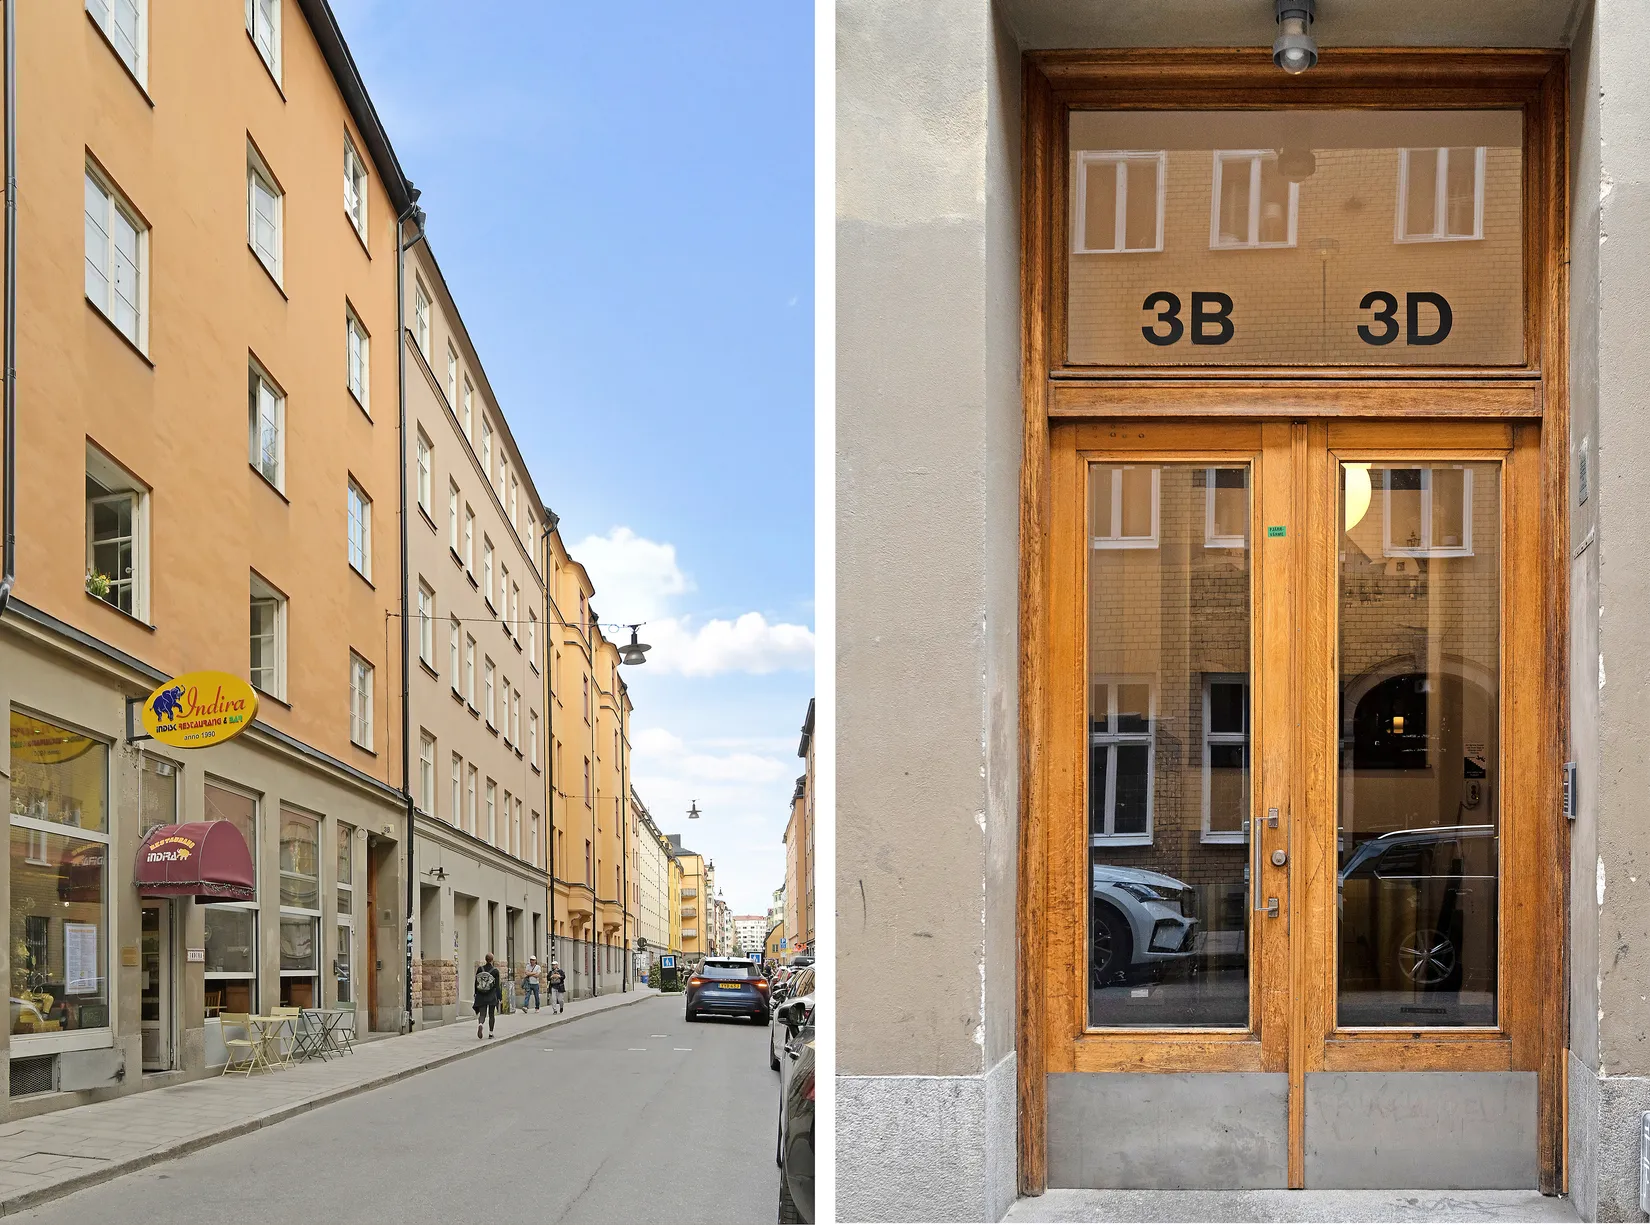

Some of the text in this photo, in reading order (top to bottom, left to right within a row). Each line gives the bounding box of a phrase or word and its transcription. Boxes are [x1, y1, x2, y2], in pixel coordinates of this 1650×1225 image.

[1141, 291, 1235, 346] 3B
[1357, 291, 1453, 346] 3D
[176, 685, 247, 719] Indira
[179, 717, 222, 731] RESTAURANG
[223, 717, 228, 725] &
[229, 714, 243, 724] BAR
[184, 730, 216, 741] anno 1990
[149, 836, 195, 851] RESTAURANG
